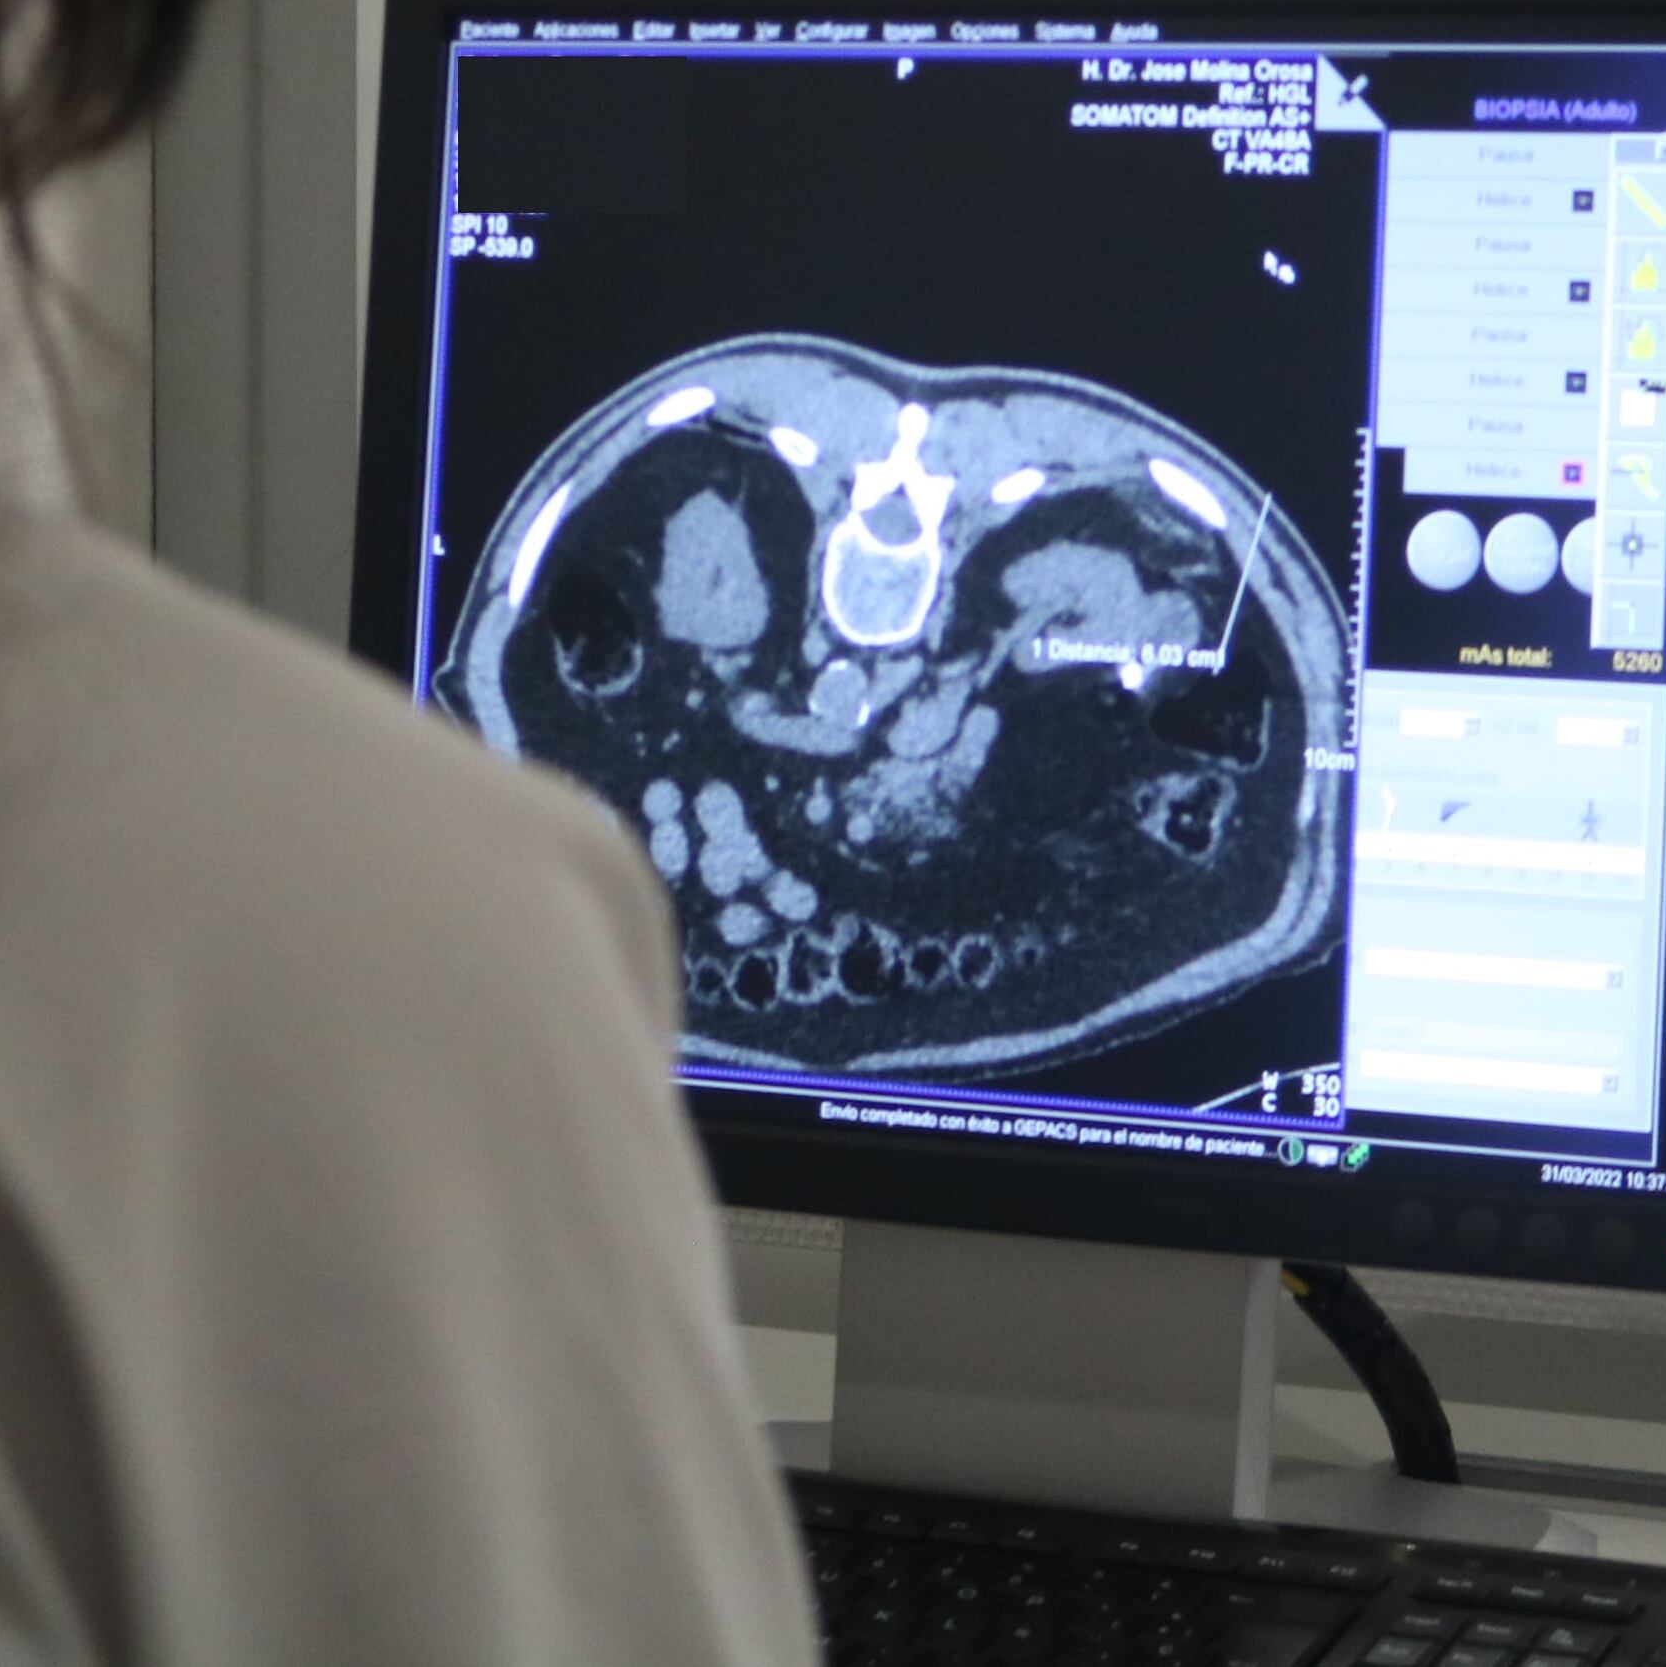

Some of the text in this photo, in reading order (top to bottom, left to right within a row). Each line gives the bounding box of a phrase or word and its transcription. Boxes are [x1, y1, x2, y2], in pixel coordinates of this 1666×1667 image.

[897, 59, 914, 79] P
[1081, 58, 1313, 82] H. Dr. Jose Molina Orosa
[1267, 82, 1312, 105] HGL
[1070, 103, 1311, 128] SOMATOM Definition AS+
[1473, 98, 1637, 123] BIOPSIA (Adulto)
[1212, 128, 1242, 151] CT
[451, 214, 508, 235] SPI 10
[449, 235, 476, 256] SP
[1458, 644, 1553, 668] mAs total:
[1302, 746, 1355, 771] 10cm
[1261, 1070, 1341, 1096] W 350
[1261, 1091, 1340, 1118] C 30
[859, 1105, 937, 1128] completado
[939, 1114, 966, 1130] con
[1013, 1117, 1077, 1140] GEPACS
[1079, 1126, 1111, 1144] para
[1113, 1126, 1128, 1144] el
[1128, 1127, 1182, 1149] nombre
[1184, 1133, 1204, 1152] de
[1540, 1162, 1623, 1189] 31/03/2022
